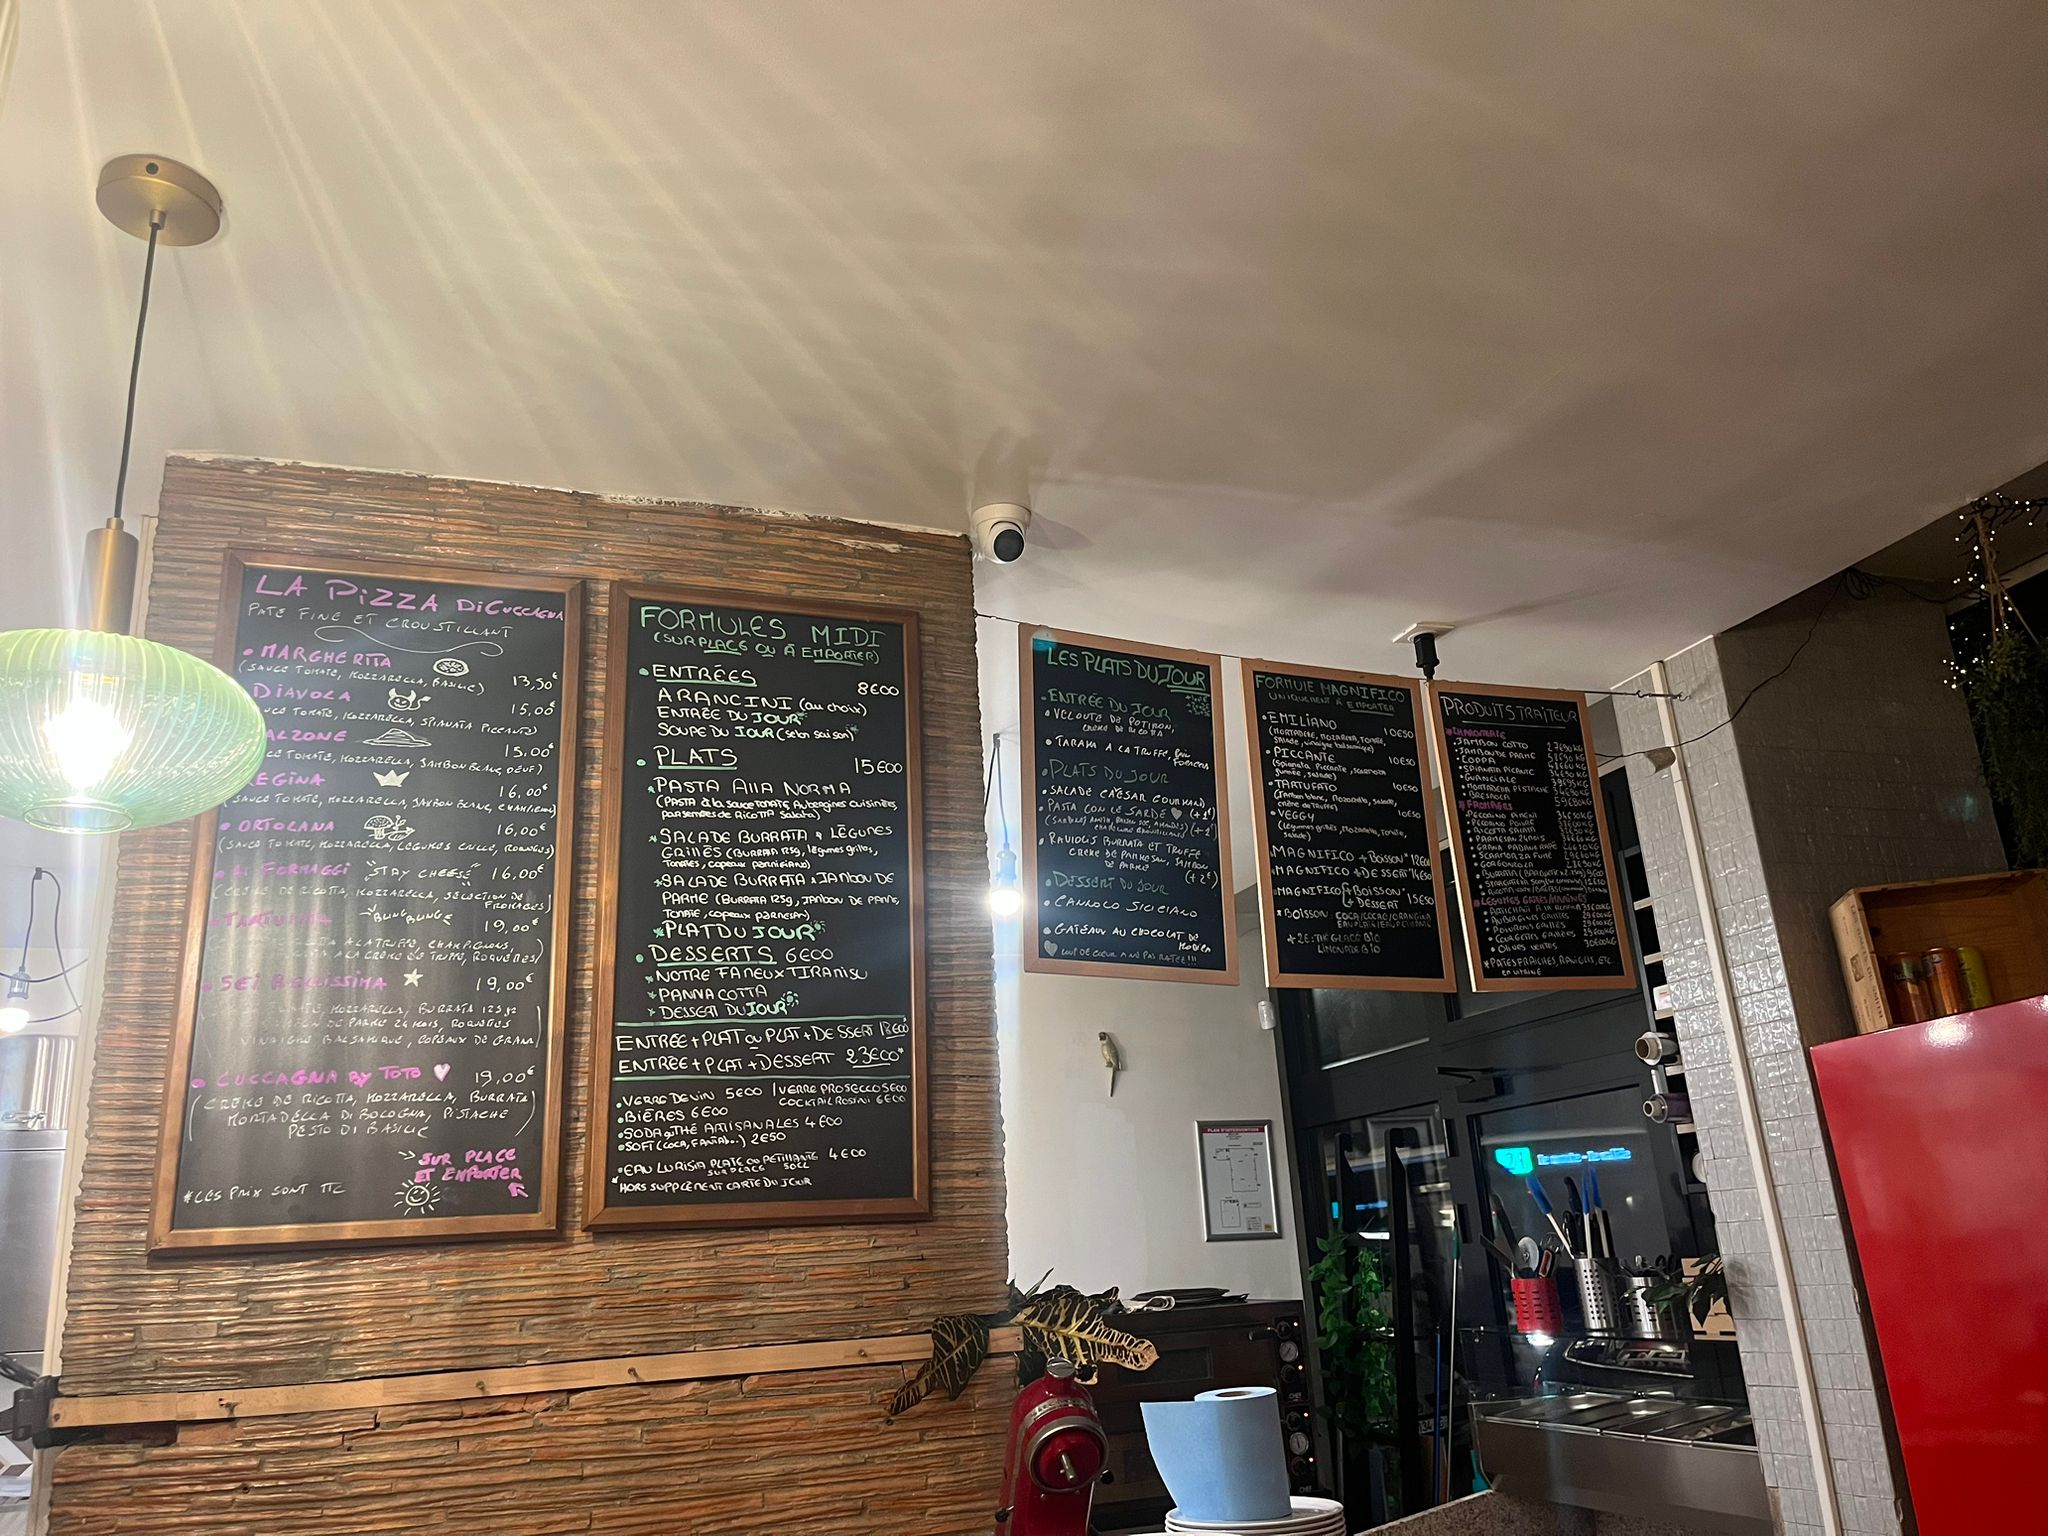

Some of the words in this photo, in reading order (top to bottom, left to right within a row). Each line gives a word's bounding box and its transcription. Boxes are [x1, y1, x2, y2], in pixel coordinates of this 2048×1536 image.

[256, 574, 308, 596] LA
[248, 602, 287, 618] PATE
[298, 607, 341, 621] FINE
[353, 613, 379, 624] ET
[386, 618, 513, 638] CROUSTILLANT
[640, 606, 786, 639] FORMULES
[811, 625, 886, 647] MIDI
[261, 643, 391, 667] MARGHERITA
[652, 664, 757, 686] ENTRÉES
[1047, 647, 1079, 667] LES
[1081, 652, 1132, 676] PLATS
[1134, 660, 1159, 683] DU
[1158, 665, 1206, 692] JOUR
[658, 687, 792, 710] ARANCINI
[1320, 682, 1405, 702] MAGNIFICO
[1048, 688, 1104, 709] ENTRÉE
[1109, 698, 1128, 712] DU
[1131, 703, 1171, 721] JOUR
[1440, 696, 1516, 721] PRODUITS
[657, 706, 721, 720] ENTRÉE
[726, 709, 748, 721] DU
[267, 729, 348, 741] ALZONE
[658, 722, 707, 737] SOUPE
[709, 725, 729, 737] DU
[734, 726, 774, 738] JOUR
[1502, 740, 1529, 749] COTTO
[653, 746, 738, 769] PLATS
[1274, 746, 1336, 764] PICCANTE
[1461, 755, 1496, 764] COPPA
[1049, 759, 1097, 779] PLATS
[1104, 766, 1123, 780] DU
[1124, 770, 1169, 784] JOUR
[653, 777, 720, 793] PASTA
[783, 781, 851, 796] NORMA
[1274, 779, 1337, 792] TARTUFATO
[1048, 798, 1077, 812] PASTA
[1084, 803, 1105, 814] CON
[1125, 806, 1166, 819] SARDE
[238, 817, 335, 832] ORTOLANA
[660, 828, 730, 845] SALADE
[738, 829, 807, 844] BURRATA
[1272, 845, 1355, 862] MAGNIFICO
[1275, 865, 1350, 877] MAGNIFICO
[662, 874, 727, 888] SALADE
[734, 872, 805, 888] BURRATA
[874, 873, 894, 884] DE
[1053, 870, 1115, 889] DESSERT
[1120, 878, 1133, 890] DU
[1137, 880, 1169, 895] JOUR
[662, 891, 709, 905] PARME
[752, 924, 815, 941] JOUR
[1113, 929, 1126, 937] AU
[1131, 928, 1185, 941] CHOCOLAT
[648, 944, 774, 963] DESSERTS
[656, 969, 710, 982] NOTRE
[658, 988, 714, 1002] PANNA
[718, 984, 768, 1000] COTTA
[724, 1003, 747, 1016] DU
[475, 1035, 488, 1045] DE
[217, 1069, 337, 1088] CUCCAGNA
[379, 1065, 422, 1080] TOTO
[273, 1095, 292, 1106] DE
[622, 1095, 667, 1107] VERRE
[228, 1110, 332, 1126] MORTADELLA
[289, 1123, 332, 1139] PESTO
[623, 1128, 662, 1140] SODA
[704, 1118, 799, 1134] ARTISANALES
[418, 1153, 451, 1165] SUR
[465, 1148, 516, 1164] PLACE
[414, 1168, 435, 1183] ET
[623, 1164, 653, 1177] EAU
[271, 1183, 309, 1196] SONT
[620, 1182, 647, 1193] HORS
[726, 1178, 760, 1190] CARTE
